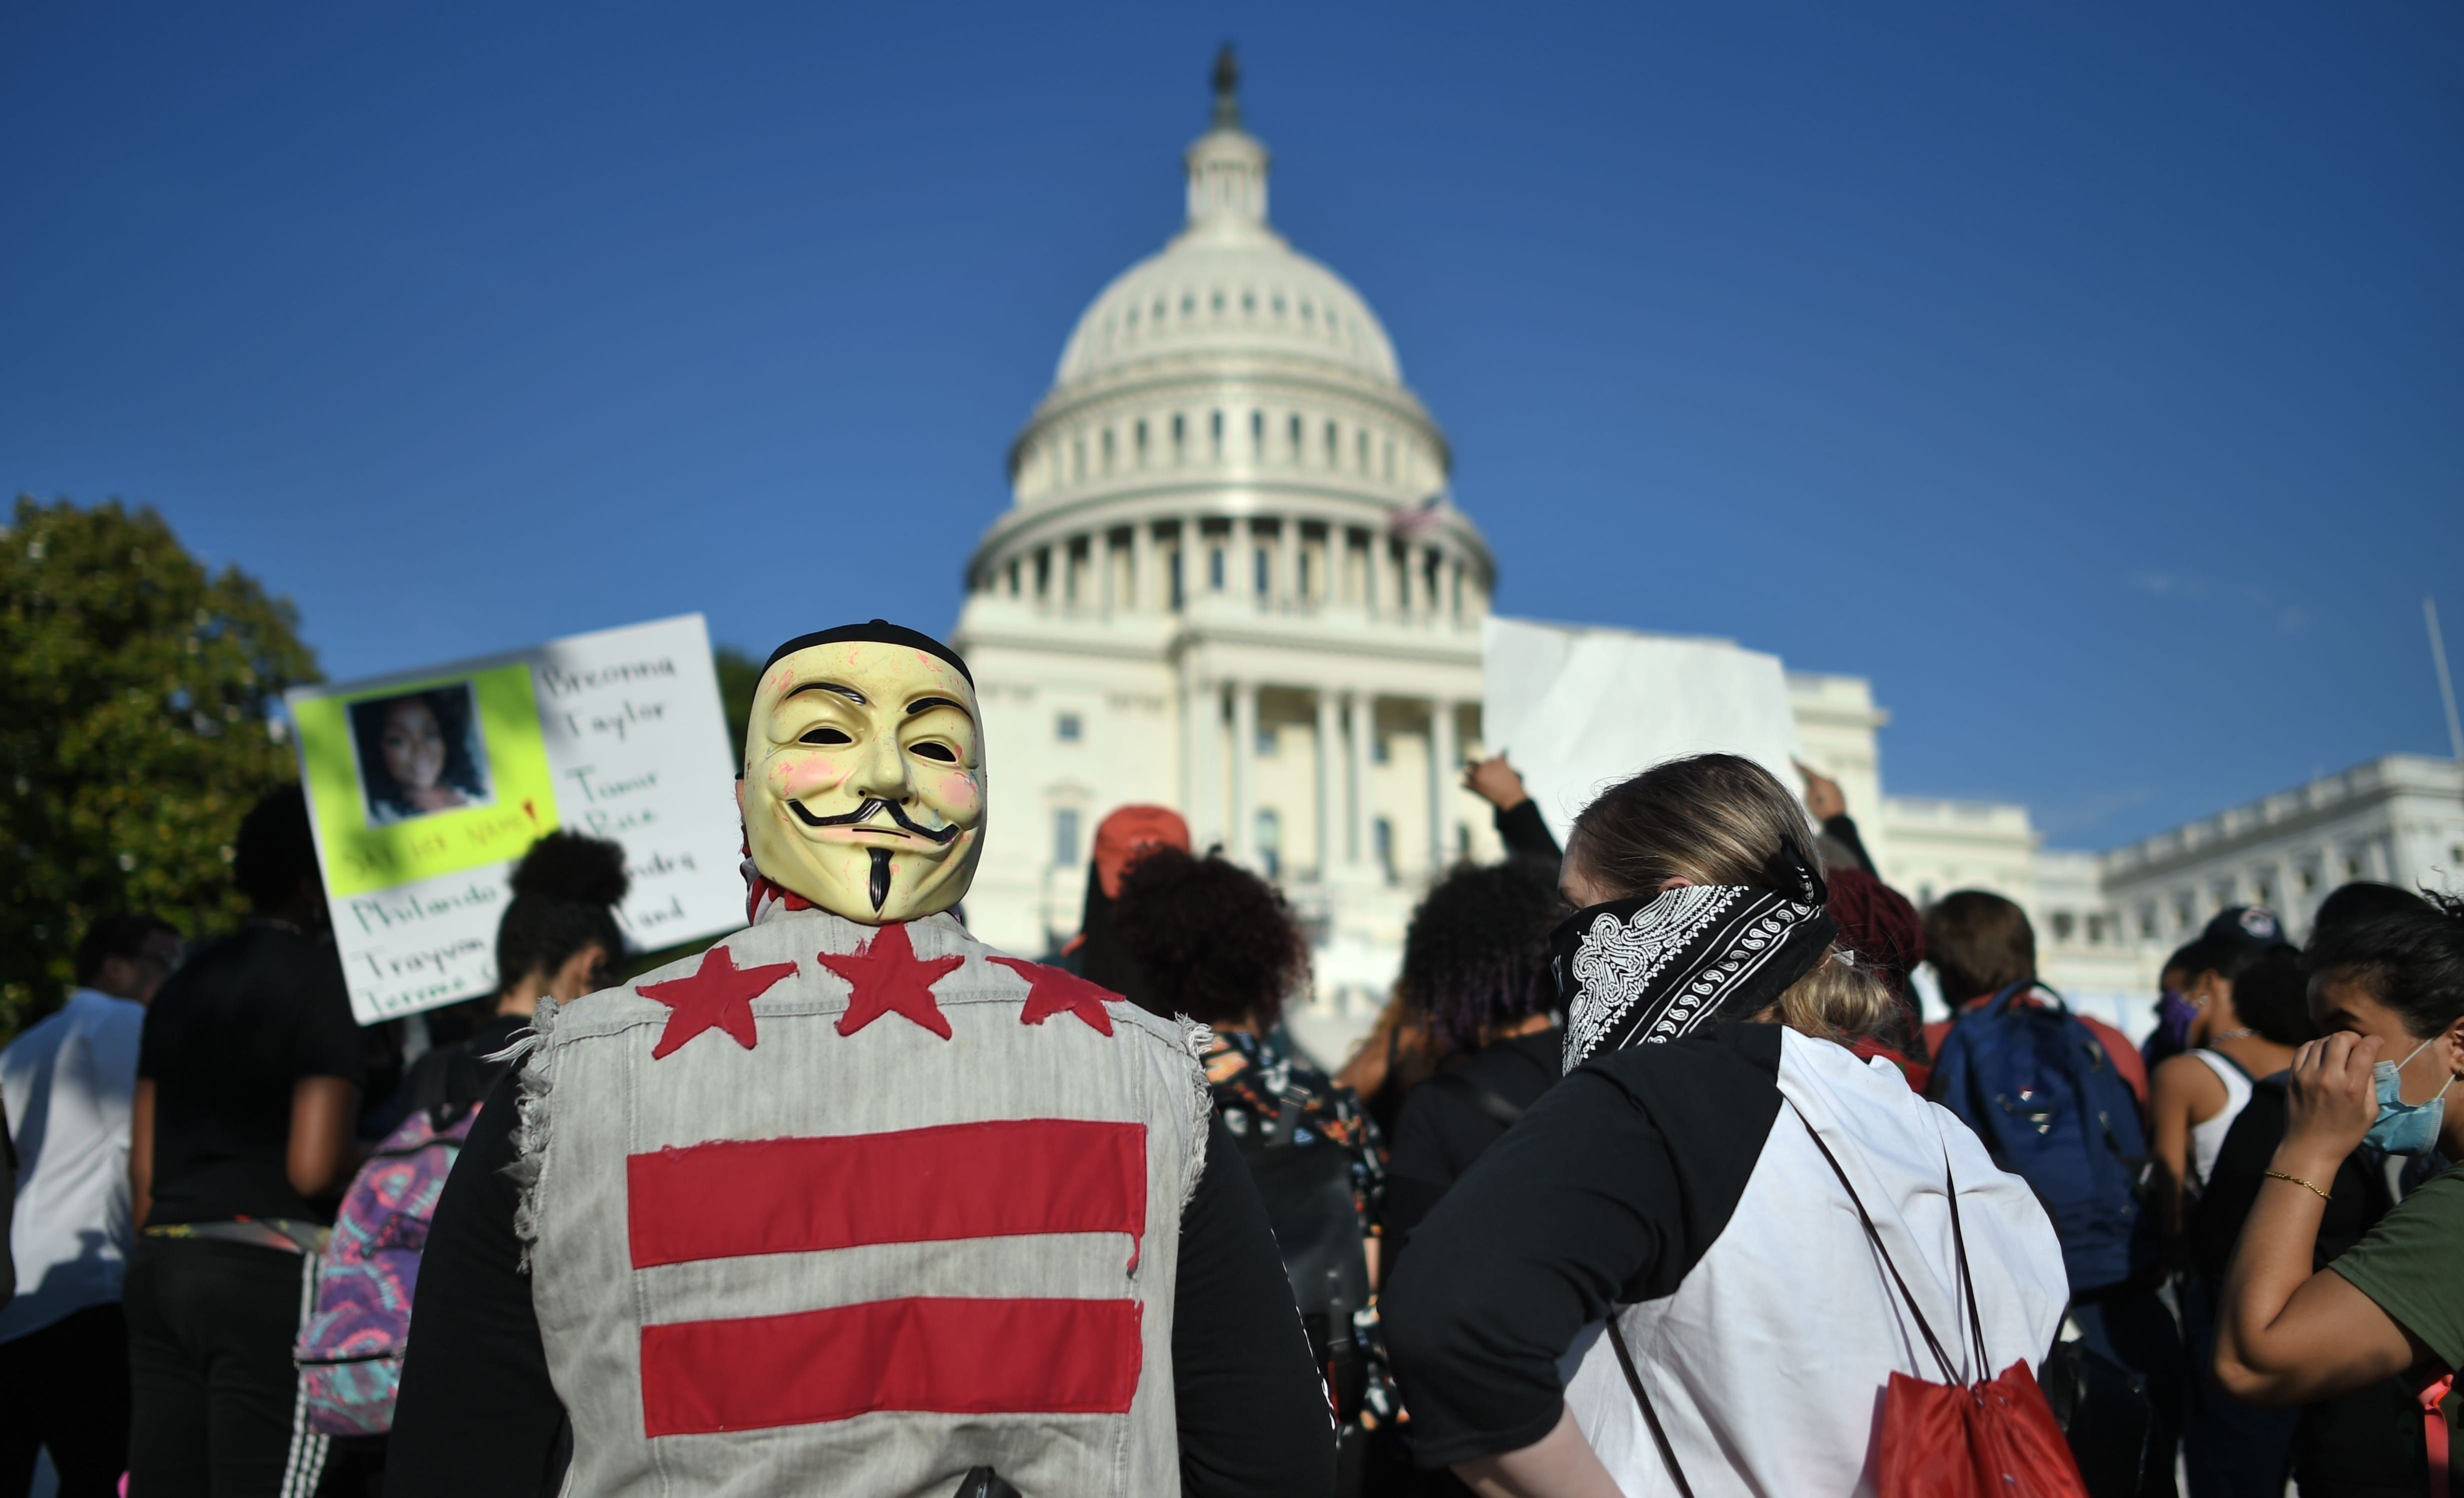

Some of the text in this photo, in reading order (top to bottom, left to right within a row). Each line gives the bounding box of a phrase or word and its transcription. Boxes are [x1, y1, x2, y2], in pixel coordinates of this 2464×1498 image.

[542, 656, 677, 697] Breonna
[563, 699, 665, 741] Taylor
[618, 894, 685, 929] land
